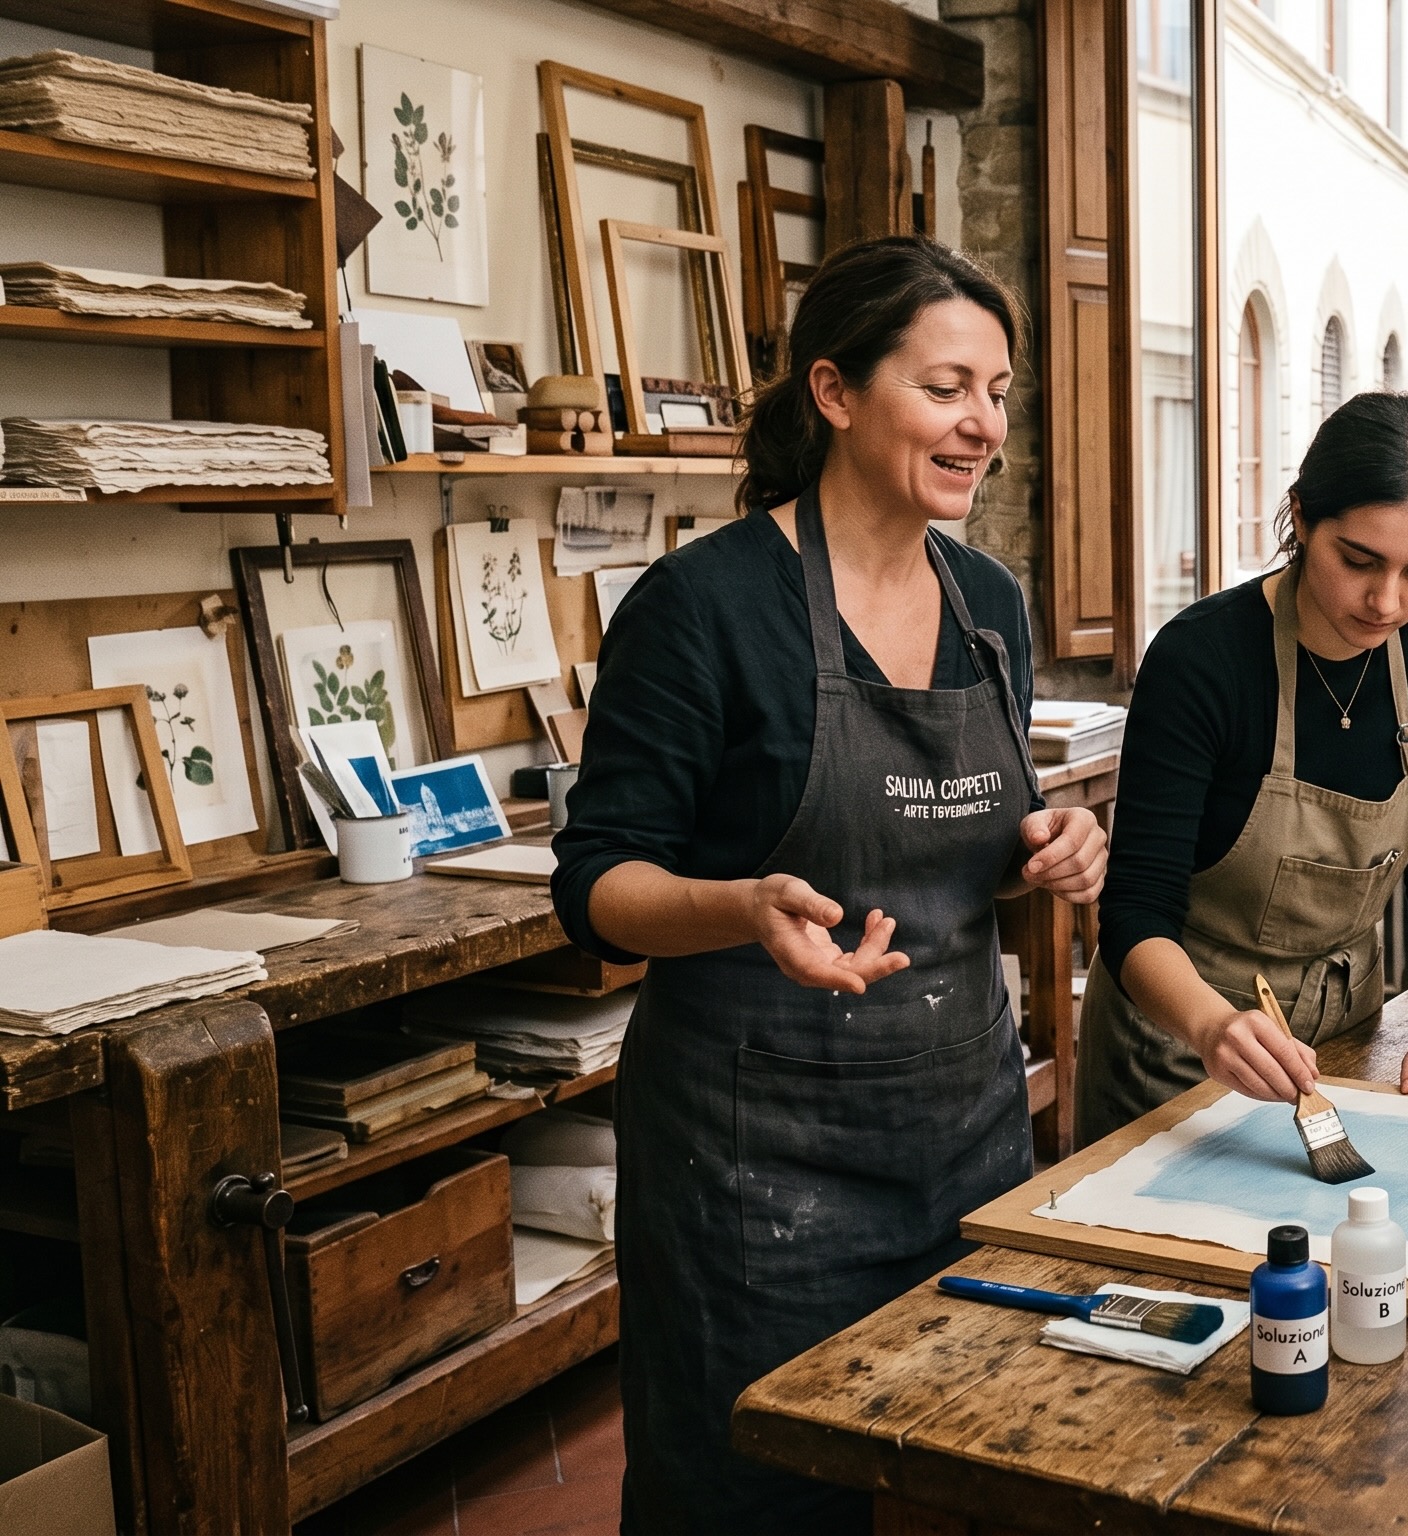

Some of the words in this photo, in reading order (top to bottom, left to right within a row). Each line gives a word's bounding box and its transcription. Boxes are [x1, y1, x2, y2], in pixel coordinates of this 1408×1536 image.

[940, 771, 1002, 800] COPPETTI
[903, 804, 930, 819] ARTE
[1342, 1279, 1405, 1298] Soluzione
[1379, 1302, 1390, 1319] B
[1257, 1323, 1325, 1344] Soluzione
[1293, 1348, 1307, 1365] A
